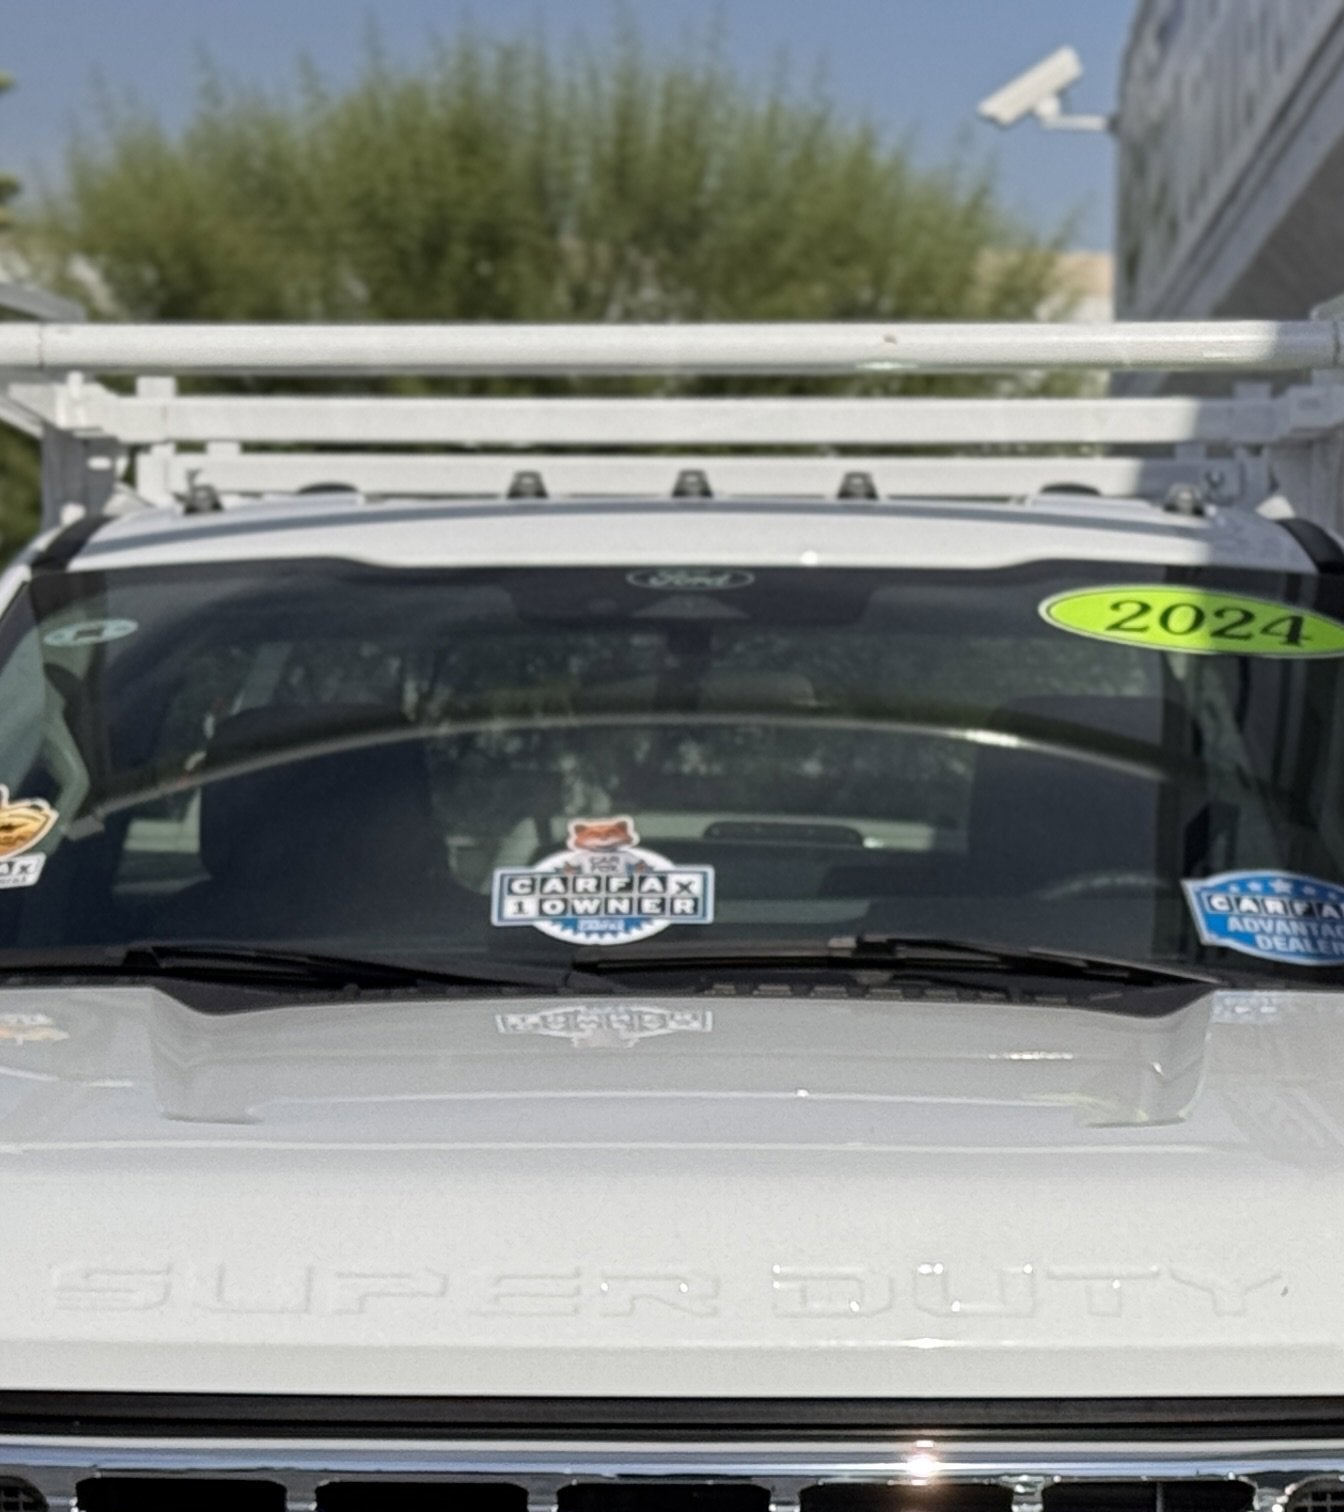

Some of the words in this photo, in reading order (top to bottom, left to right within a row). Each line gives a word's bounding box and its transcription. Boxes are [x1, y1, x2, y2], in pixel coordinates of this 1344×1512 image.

[1106, 599, 1311, 646] 2024
[510, 877, 697, 895] CARFAX
[513, 901, 533, 915] 1
[542, 899, 696, 915] OWNER
[50, 1262, 720, 1315] SUPER
[770, 1264, 1284, 1316] DUTY
